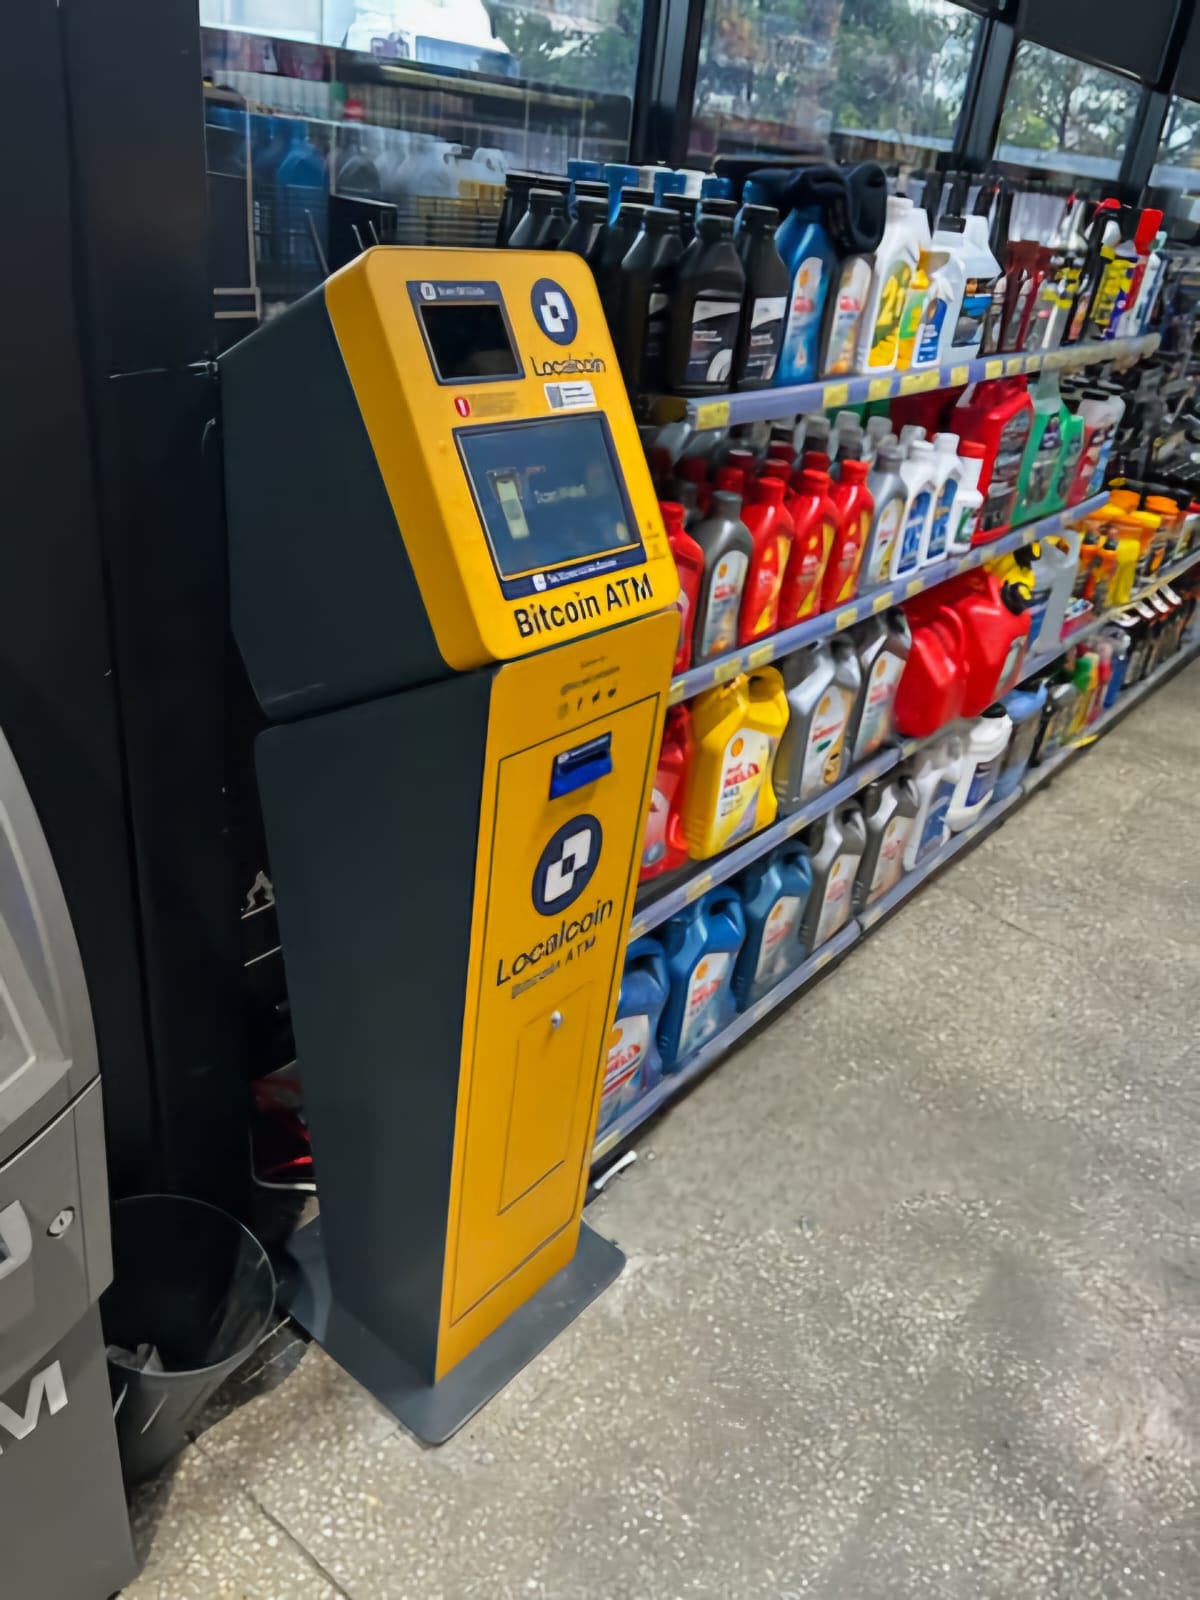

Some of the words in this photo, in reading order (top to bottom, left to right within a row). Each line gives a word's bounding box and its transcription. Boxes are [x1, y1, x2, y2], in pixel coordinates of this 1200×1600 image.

[514, 592, 600, 638] Bitcoin
[606, 573, 653, 611] ATM
[496, 899, 613, 987] Localcoin
